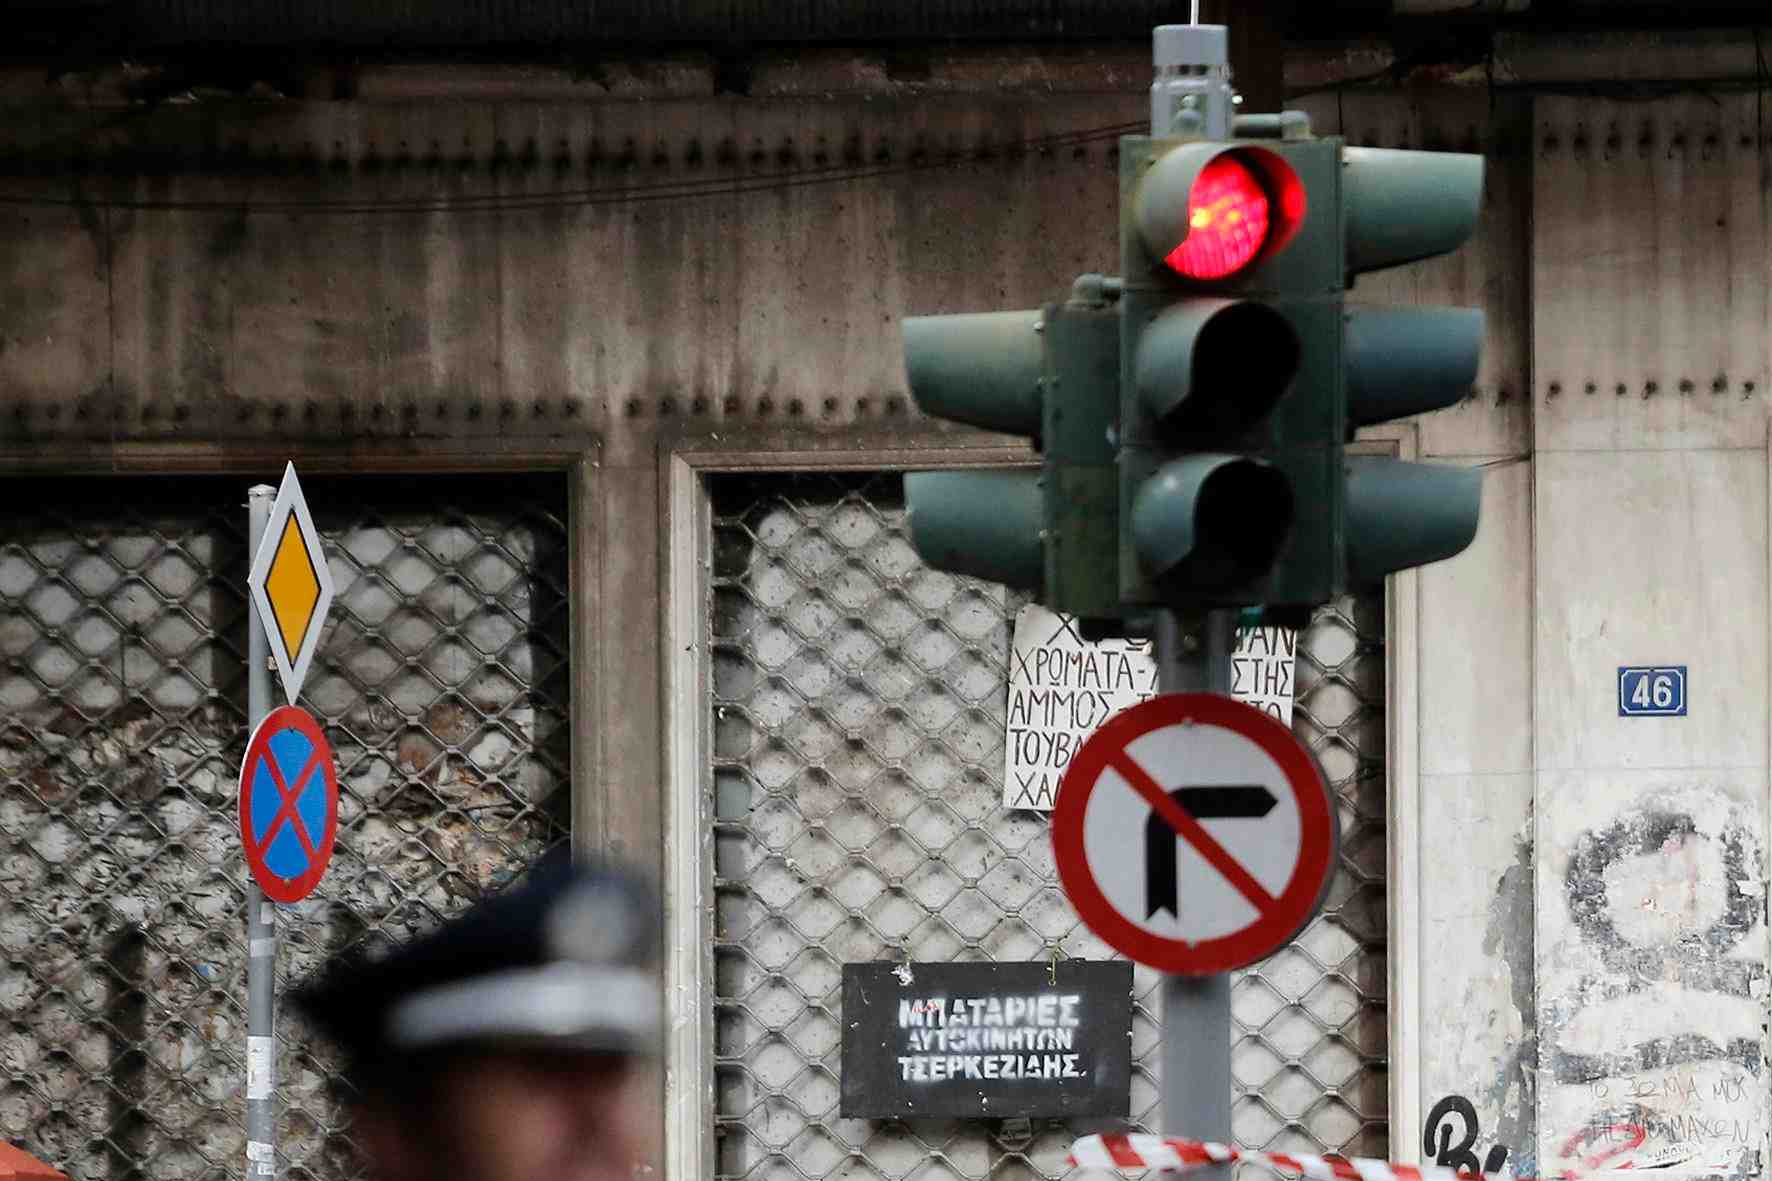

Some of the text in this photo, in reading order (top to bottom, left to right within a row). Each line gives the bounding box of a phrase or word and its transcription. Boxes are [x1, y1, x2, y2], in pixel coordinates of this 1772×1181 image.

[1631, 675, 1672, 708] 46
[1009, 688, 1115, 730] ΑΜΜΟΣ
[898, 994, 1081, 1029] ΜΠΑΤΑΡΙΕΣ
[907, 1027, 1073, 1051] ΑΥΤΟΚΙΝΗΤΩΝ
